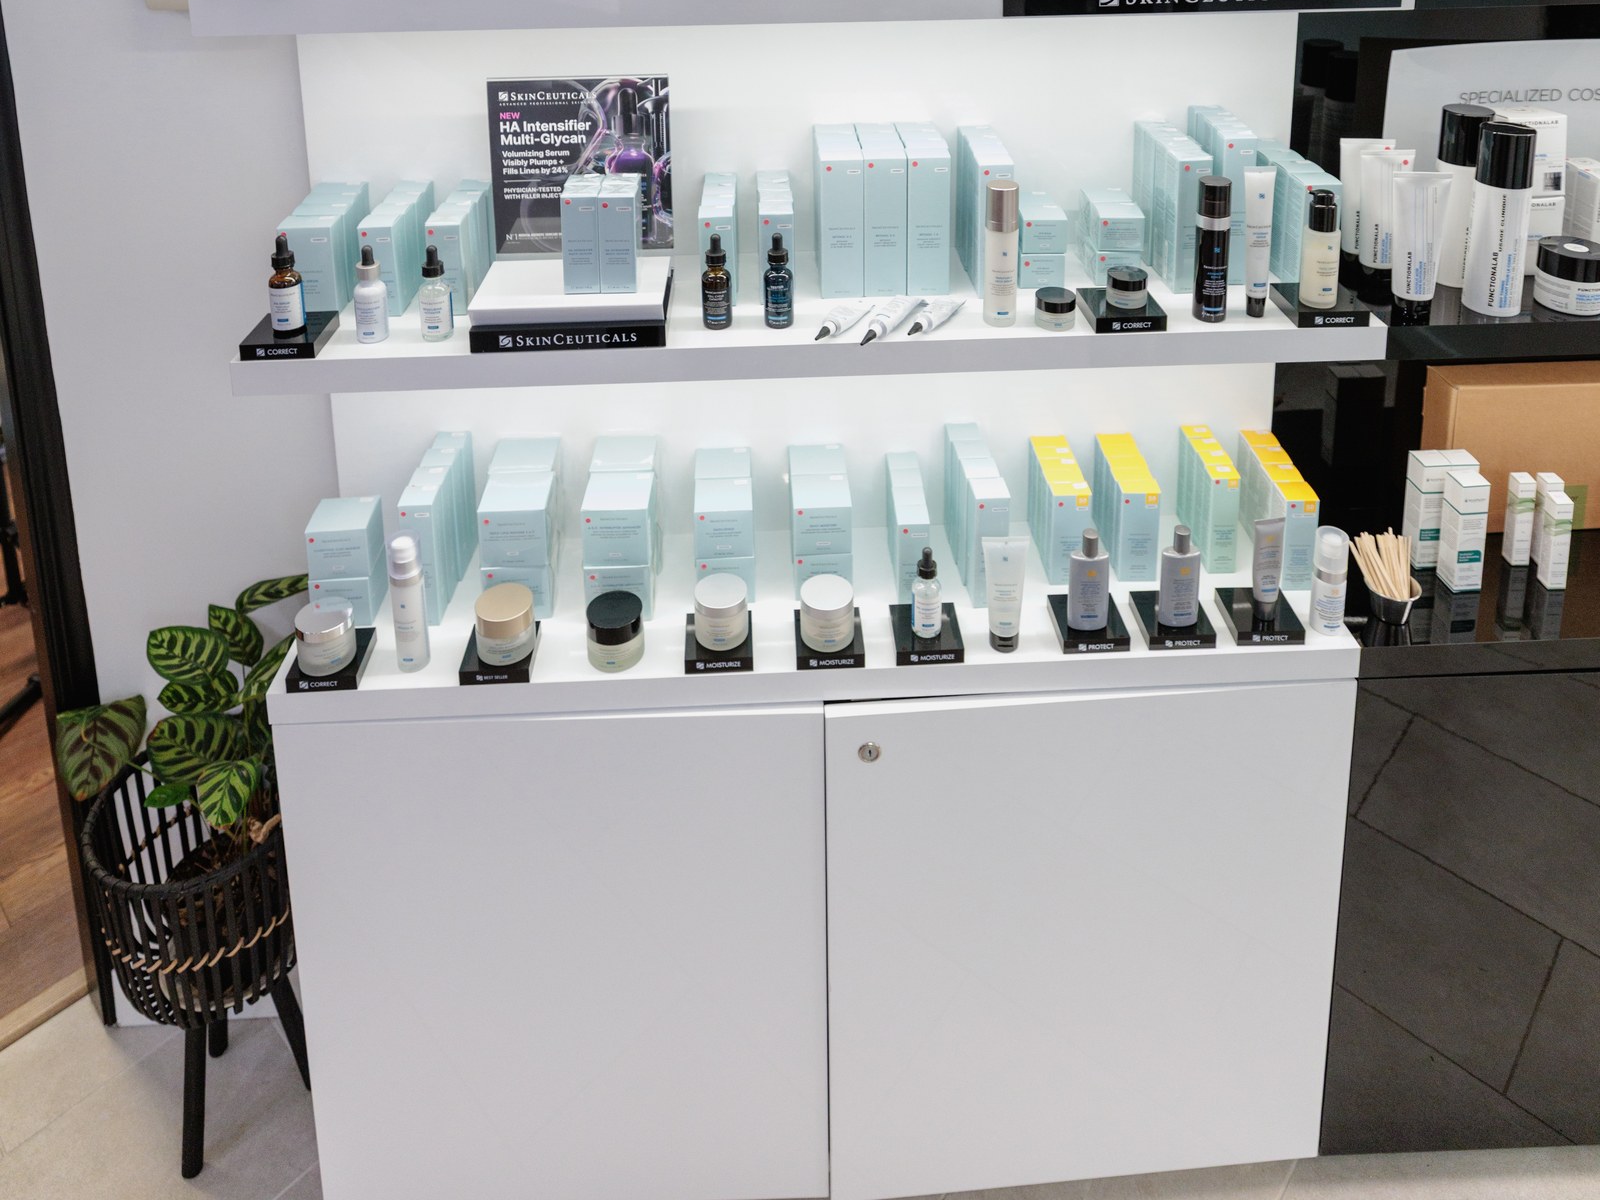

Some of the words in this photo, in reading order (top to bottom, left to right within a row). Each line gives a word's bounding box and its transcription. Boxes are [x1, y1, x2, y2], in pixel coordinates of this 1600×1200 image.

[510, 91, 598, 101] SKINCEUTICALS
[1459, 88, 1563, 105] SPECIALIZED
[499, 111, 521, 120] NEW
[500, 121, 521, 133] HA
[523, 119, 592, 132] Intensifier
[500, 132, 587, 147] Multi-Glycan
[502, 150, 543, 159] Volumizing
[544, 149, 570, 157] Serum
[502, 159, 528, 167] Visibly
[529, 158, 558, 167] Plumps
[502, 167, 519, 175] Fills
[519, 167, 539, 175] Lines
[540, 167, 551, 176] by
[551, 166, 569, 174] 24%
[1488, 251, 1499, 307] FUNCTIONALAB
[1325, 316, 1356, 324] CORRECT
[1122, 321, 1152, 329] CORRECT
[515, 332, 638, 347] SKINCEUTICALS
[267, 348, 298, 356] CORRECT
[1261, 634, 1289, 642] PROTECT
[1088, 643, 1115, 651] PROTECT
[1174, 639, 1202, 648] PROTECT
[920, 653, 956, 662] MOISTURIZE
[706, 660, 742, 669] MOISTURIZE
[819, 658, 855, 667] MOISTURIZE
[309, 680, 338, 688] CORRECT
